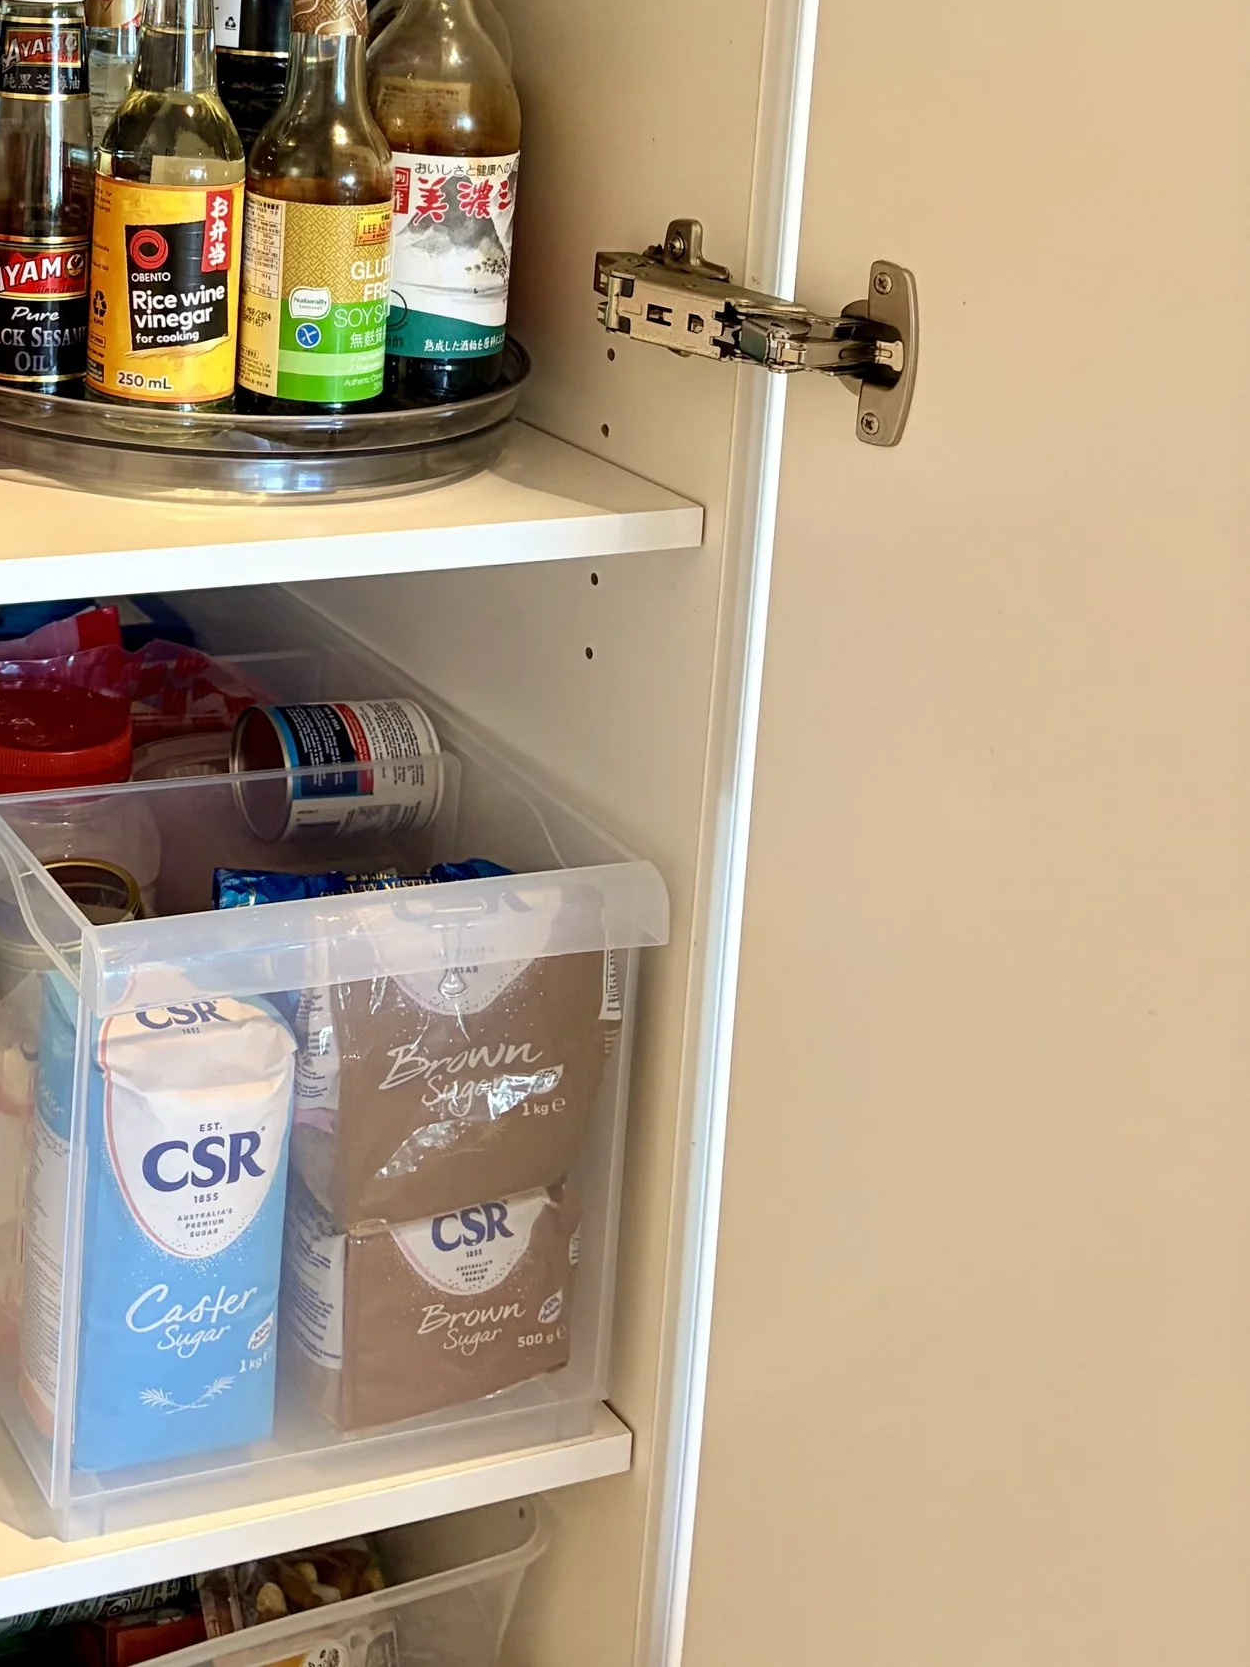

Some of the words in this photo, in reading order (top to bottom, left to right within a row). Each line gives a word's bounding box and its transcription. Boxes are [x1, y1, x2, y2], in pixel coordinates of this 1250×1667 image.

[363, 223, 377, 234] LEE
[131, 272, 171, 283] OBENTO
[132, 290, 178, 310] Rice
[180, 284, 226, 308] wine
[294, 295, 327, 307] Naturally
[11, 306, 61, 322] Pure
[134, 306, 214, 331] vinegar
[334, 308, 372, 329] SOY
[136, 333, 154, 344] for
[156, 330, 200, 343] cooking
[15, 351, 50, 372] OIL
[118, 372, 144, 387] 250
[148, 377, 172, 390] mL
[378, 1042, 543, 1091] Brown
[522, 1103, 530, 1117] 1
[533, 1104, 549, 1119] kg
[199, 1121, 224, 1133] EST.
[142, 1131, 267, 1194] CSR
[193, 1192, 220, 1204] 1855
[177, 1207, 234, 1223] AUSTRALIA'S
[185, 1218, 225, 1230] PREMIUM
[431, 1201, 516, 1252] CSR
[189, 1228, 220, 1238] SUGAR
[125, 1283, 258, 1333] Caster
[417, 1302, 527, 1335] Brown
[156, 1324, 232, 1359] Sugar
[443, 1328, 503, 1357] Sugar
[518, 1332, 544, 1348] 500
[545, 1333, 555, 1346] g
[239, 1359, 247, 1374] 1
[249, 1357, 262, 1371] kg
